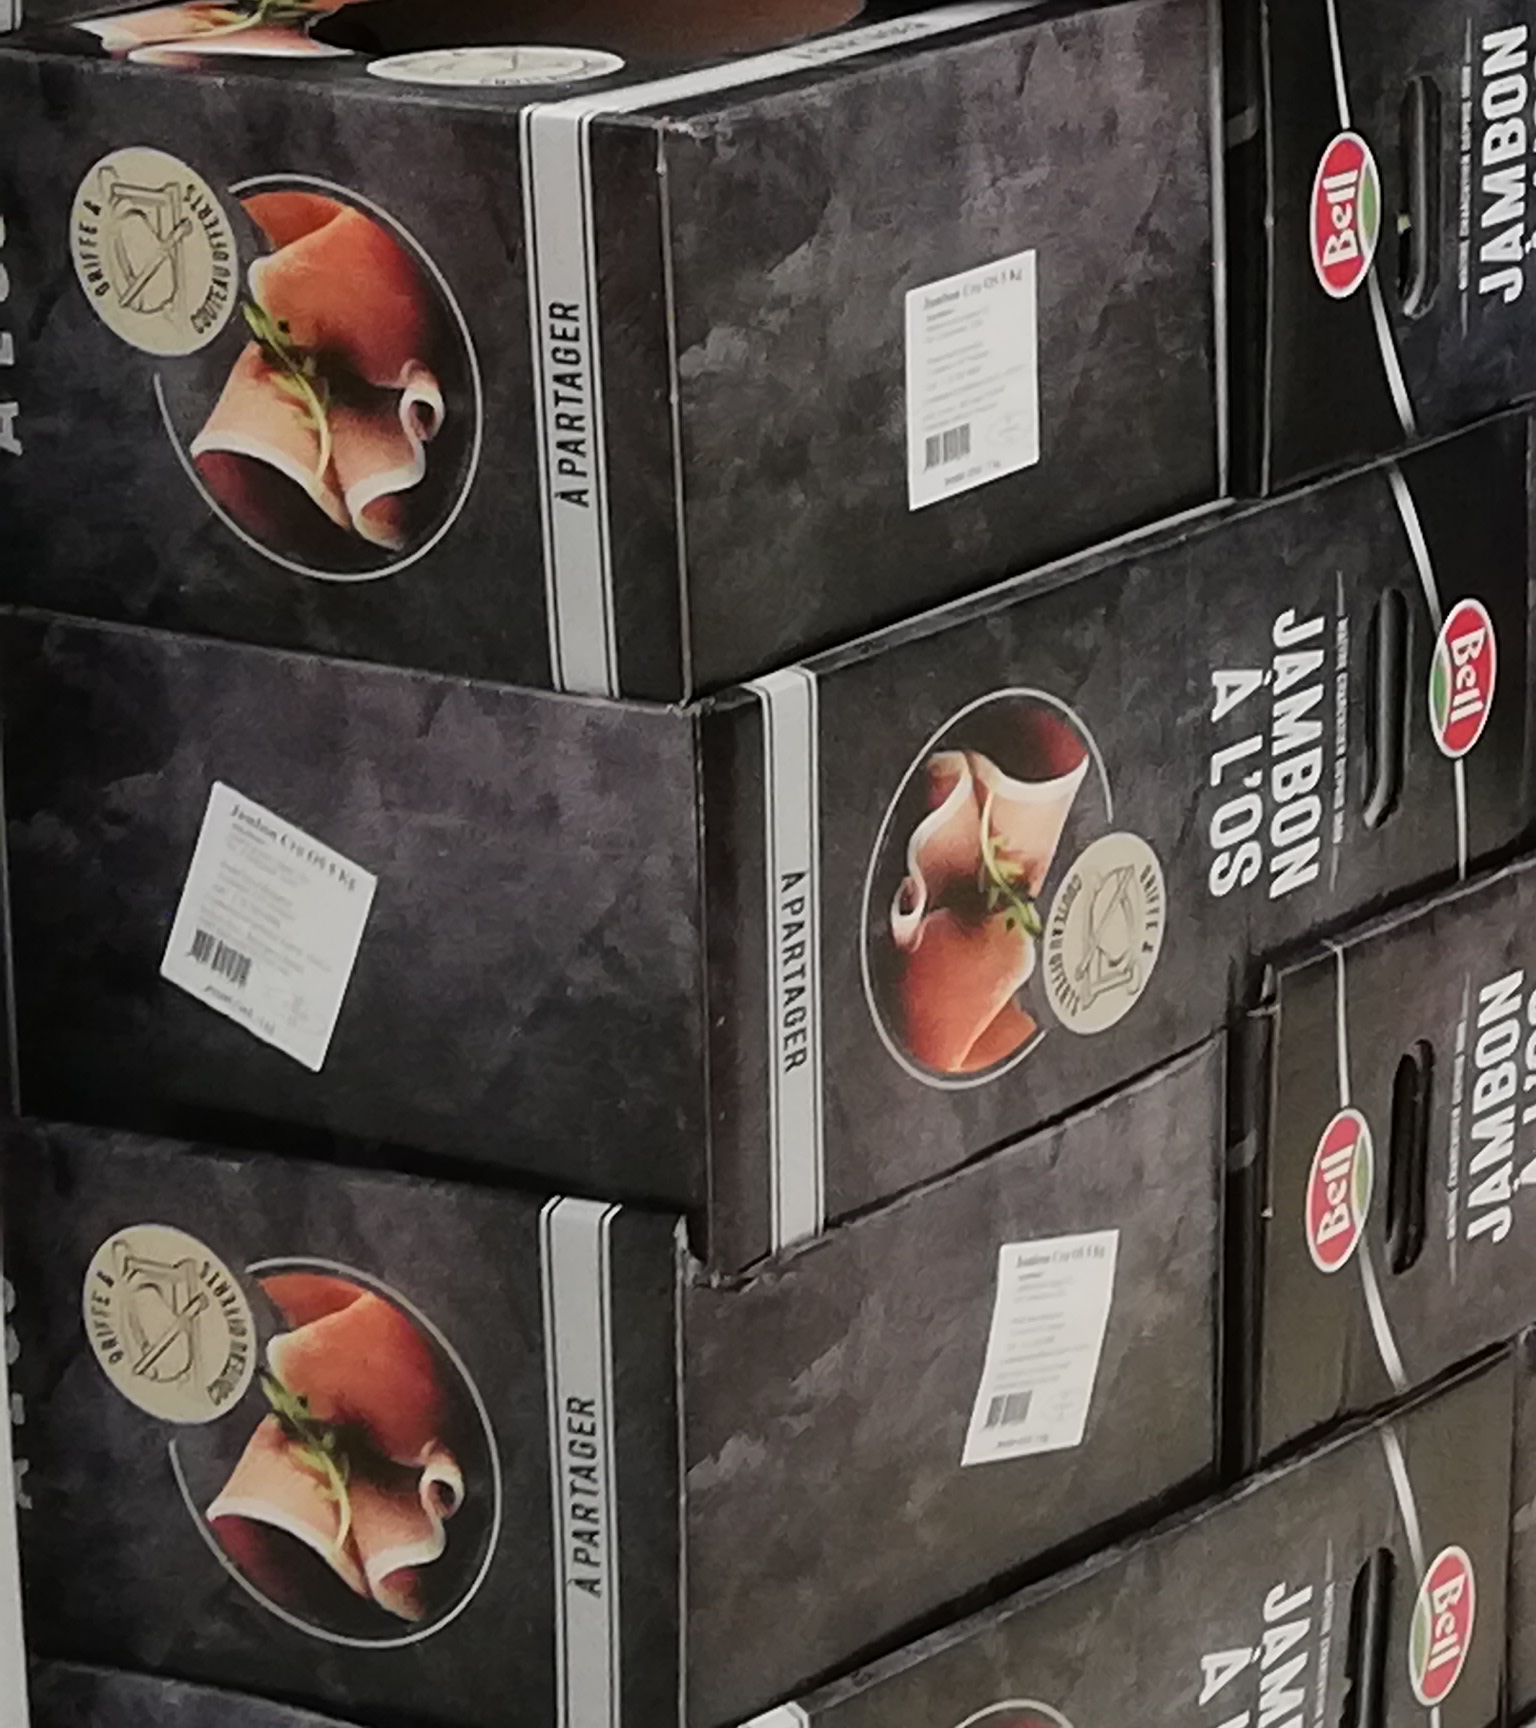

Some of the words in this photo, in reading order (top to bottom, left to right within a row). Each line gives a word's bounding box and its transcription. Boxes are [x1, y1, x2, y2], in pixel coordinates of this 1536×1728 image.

[1322, 168, 1362, 267] Bell
[1477, 24, 1529, 304] JAMBON
[547, 299, 590, 480] PARTAGER
[1268, 608, 1326, 900] JAMBON
[1452, 626, 1486, 722] Bell
[780, 894, 808, 1075] PARTAGER
[1465, 969, 1525, 1244] JAMBON
[1316, 1149, 1356, 1247] Bell
[564, 1395, 601, 1569] PARTAGER
[1426, 1572, 1467, 1671] Bell
